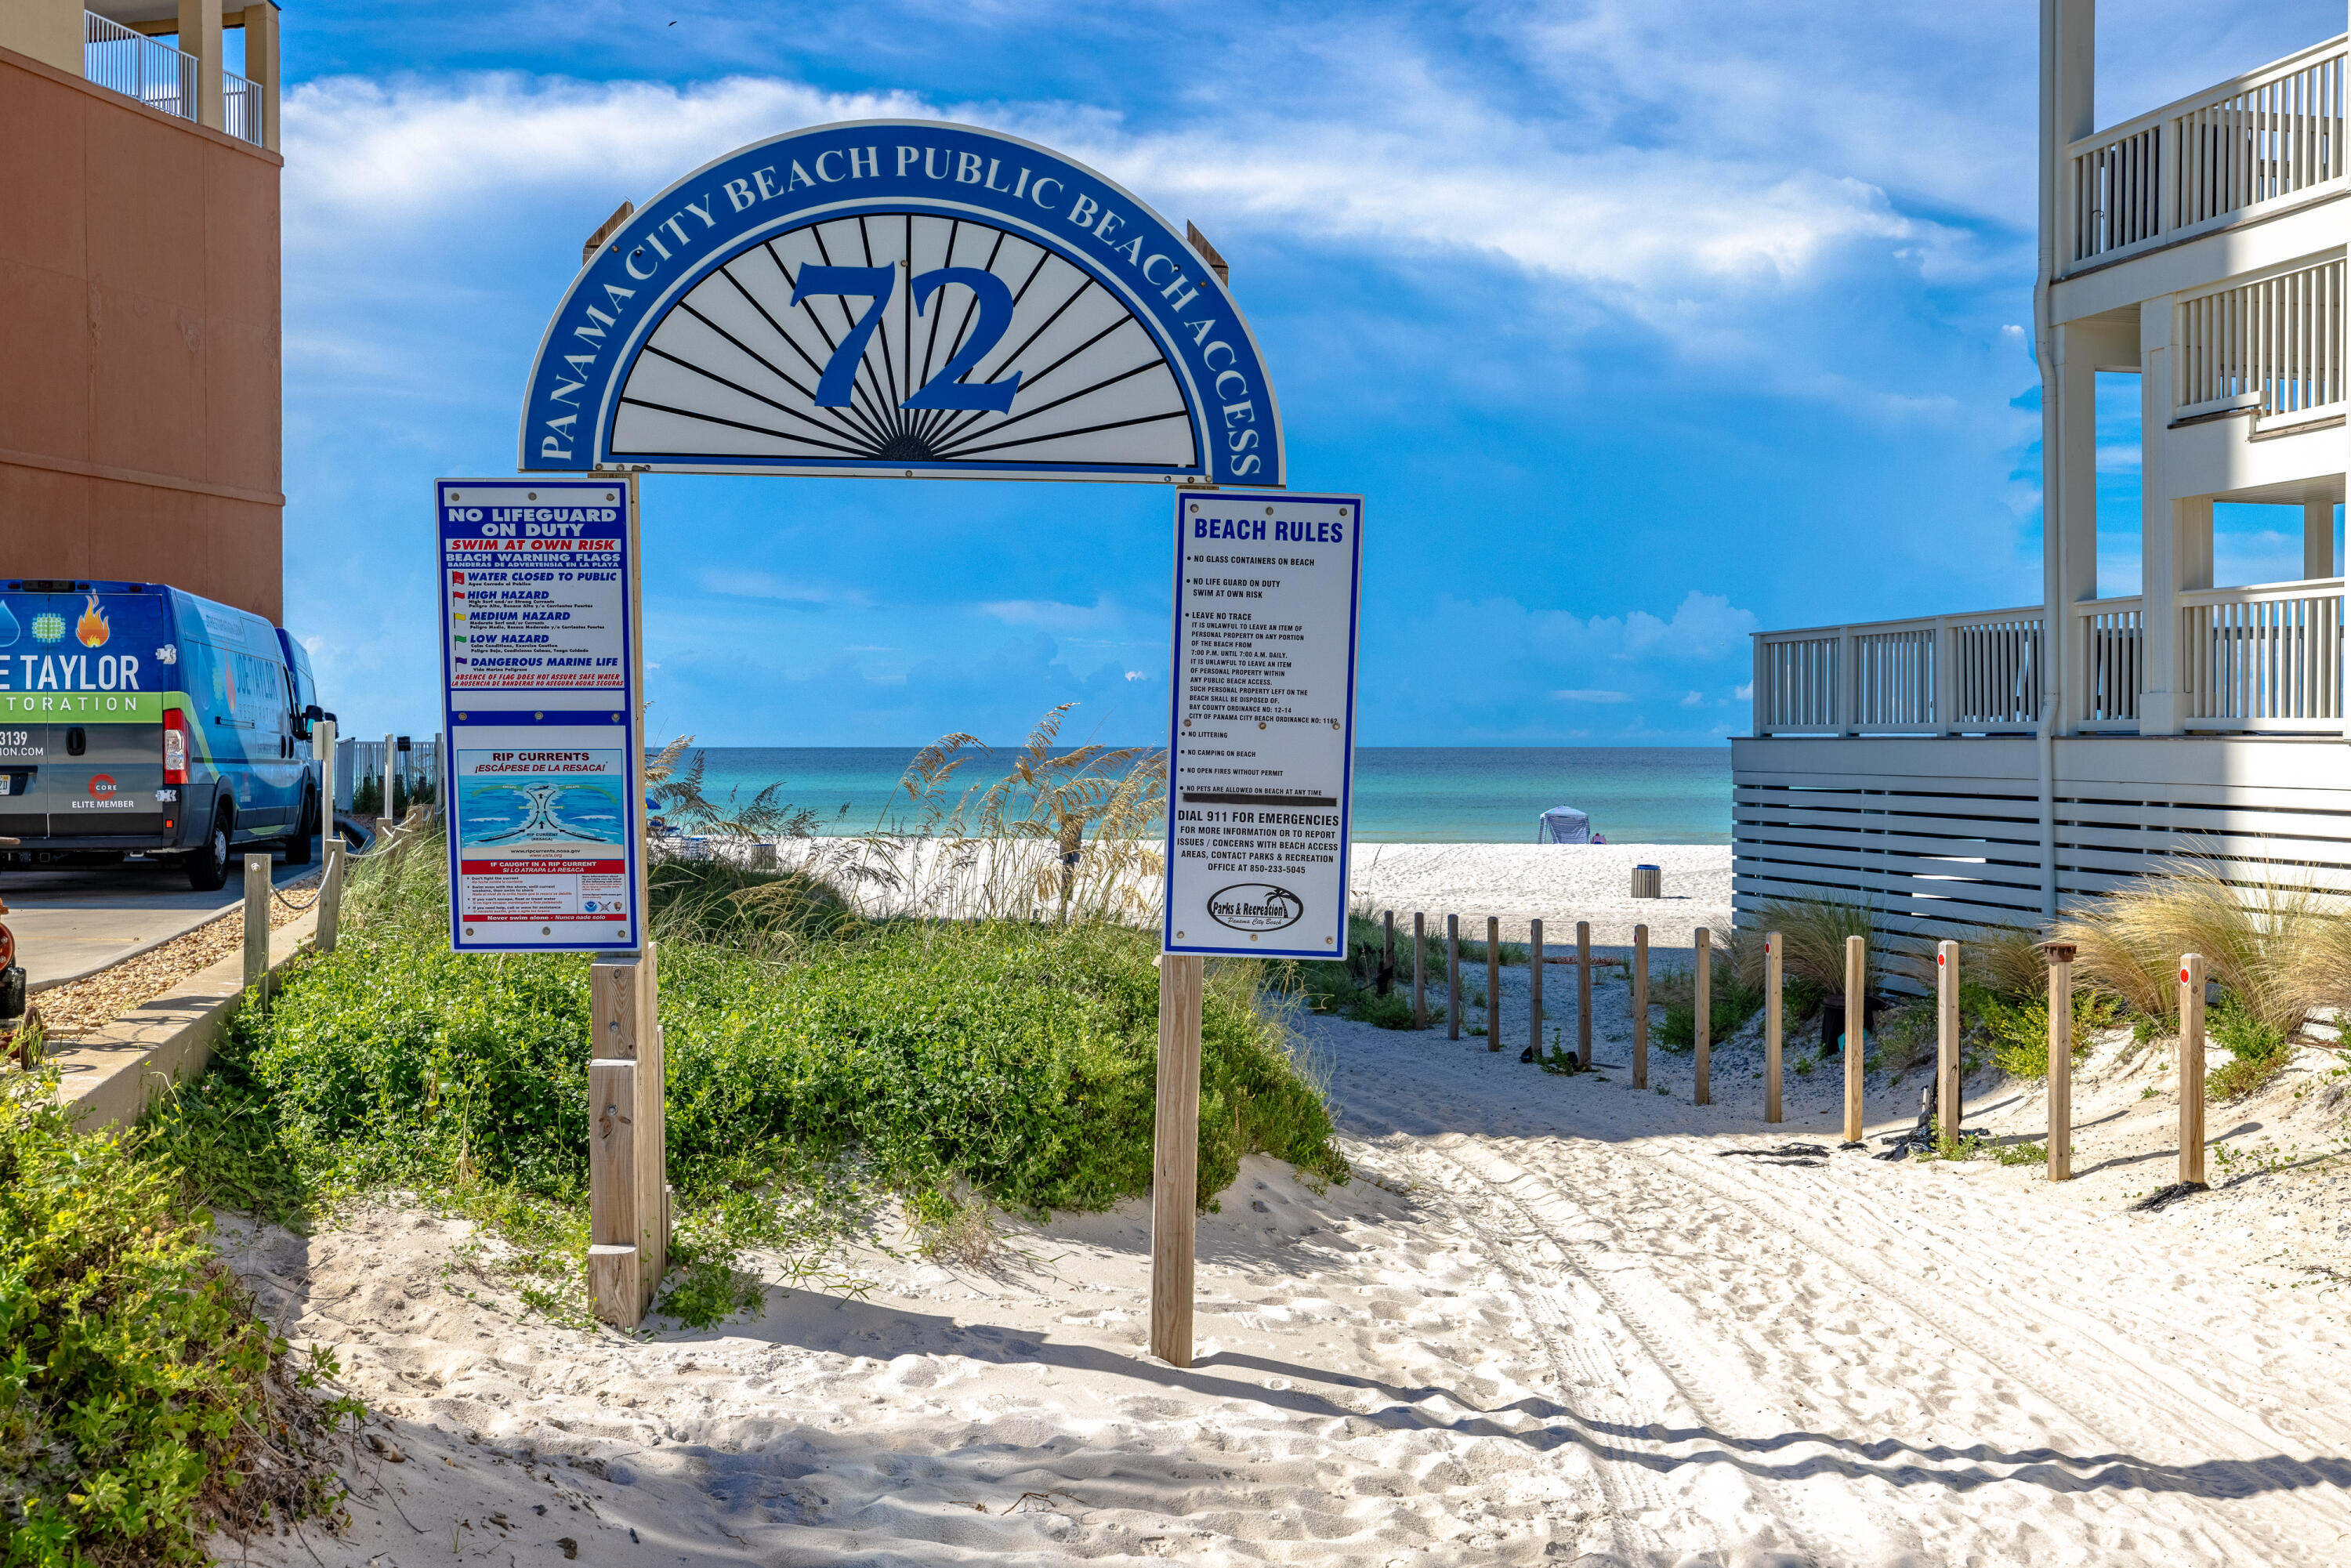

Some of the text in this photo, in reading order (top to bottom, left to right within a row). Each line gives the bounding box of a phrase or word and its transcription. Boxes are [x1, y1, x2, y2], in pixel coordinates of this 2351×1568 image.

[542, 146, 1261, 476] PANAMA CITY BEACH PUBLIC BEACH ACCESS
[790, 262, 1023, 415] 72
[448, 509, 616, 522] NO LIFEGUARD
[481, 523, 584, 536] ON DUTY
[1194, 518, 1342, 543] BEACH RULES
[451, 539, 614, 550] SWIM AT OWN RISK
[497, 553, 571, 563] WARNING
[574, 553, 620, 563] FLAGS
[1230, 556, 1276, 564] CONTAINERS
[467, 572, 616, 581] WATER CLOSED TO PUBLIC
[467, 590, 549, 599] HIGH HAZARD
[469, 611, 571, 620] MEDIUM HAZARD
[469, 634, 549, 643] LOW HAZARD
[471, 657, 618, 666] DANGEROUS MARINE LIFE
[20, 654, 139, 690] TAYLOR
[5, 696, 136, 711] TORATION
[492, 752, 589, 761] RIP CURRENTS
[474, 762, 530, 773] ¡ESCÁPESE
[1178, 809, 1339, 826] DIAL 911 FOR EMERGENCIES
[1223, 827, 1277, 836] INFORMATION
[1305, 830, 1335, 838] REPORT
[1212, 838, 1254, 848] CONCERNS
[1256, 840, 1277, 849] WITH
[1279, 841, 1305, 849] BEACH
[1307, 842, 1338, 851] ACCESS
[1181, 849, 1208, 859] AREAS,
[1211, 851, 1247, 860] CONTACT
[1249, 852, 1274, 860] PARKS
[1285, 853, 1333, 863] RECREATION
[1208, 863, 1235, 871] OFFICE
[1249, 864, 1305, 874] 850-233-5045
[1213, 902, 1234, 915] Parks
[1243, 902, 1283, 916] Recreation
[1227, 917, 1250, 925] Panama
[1266, 918, 1283, 926] Beach
